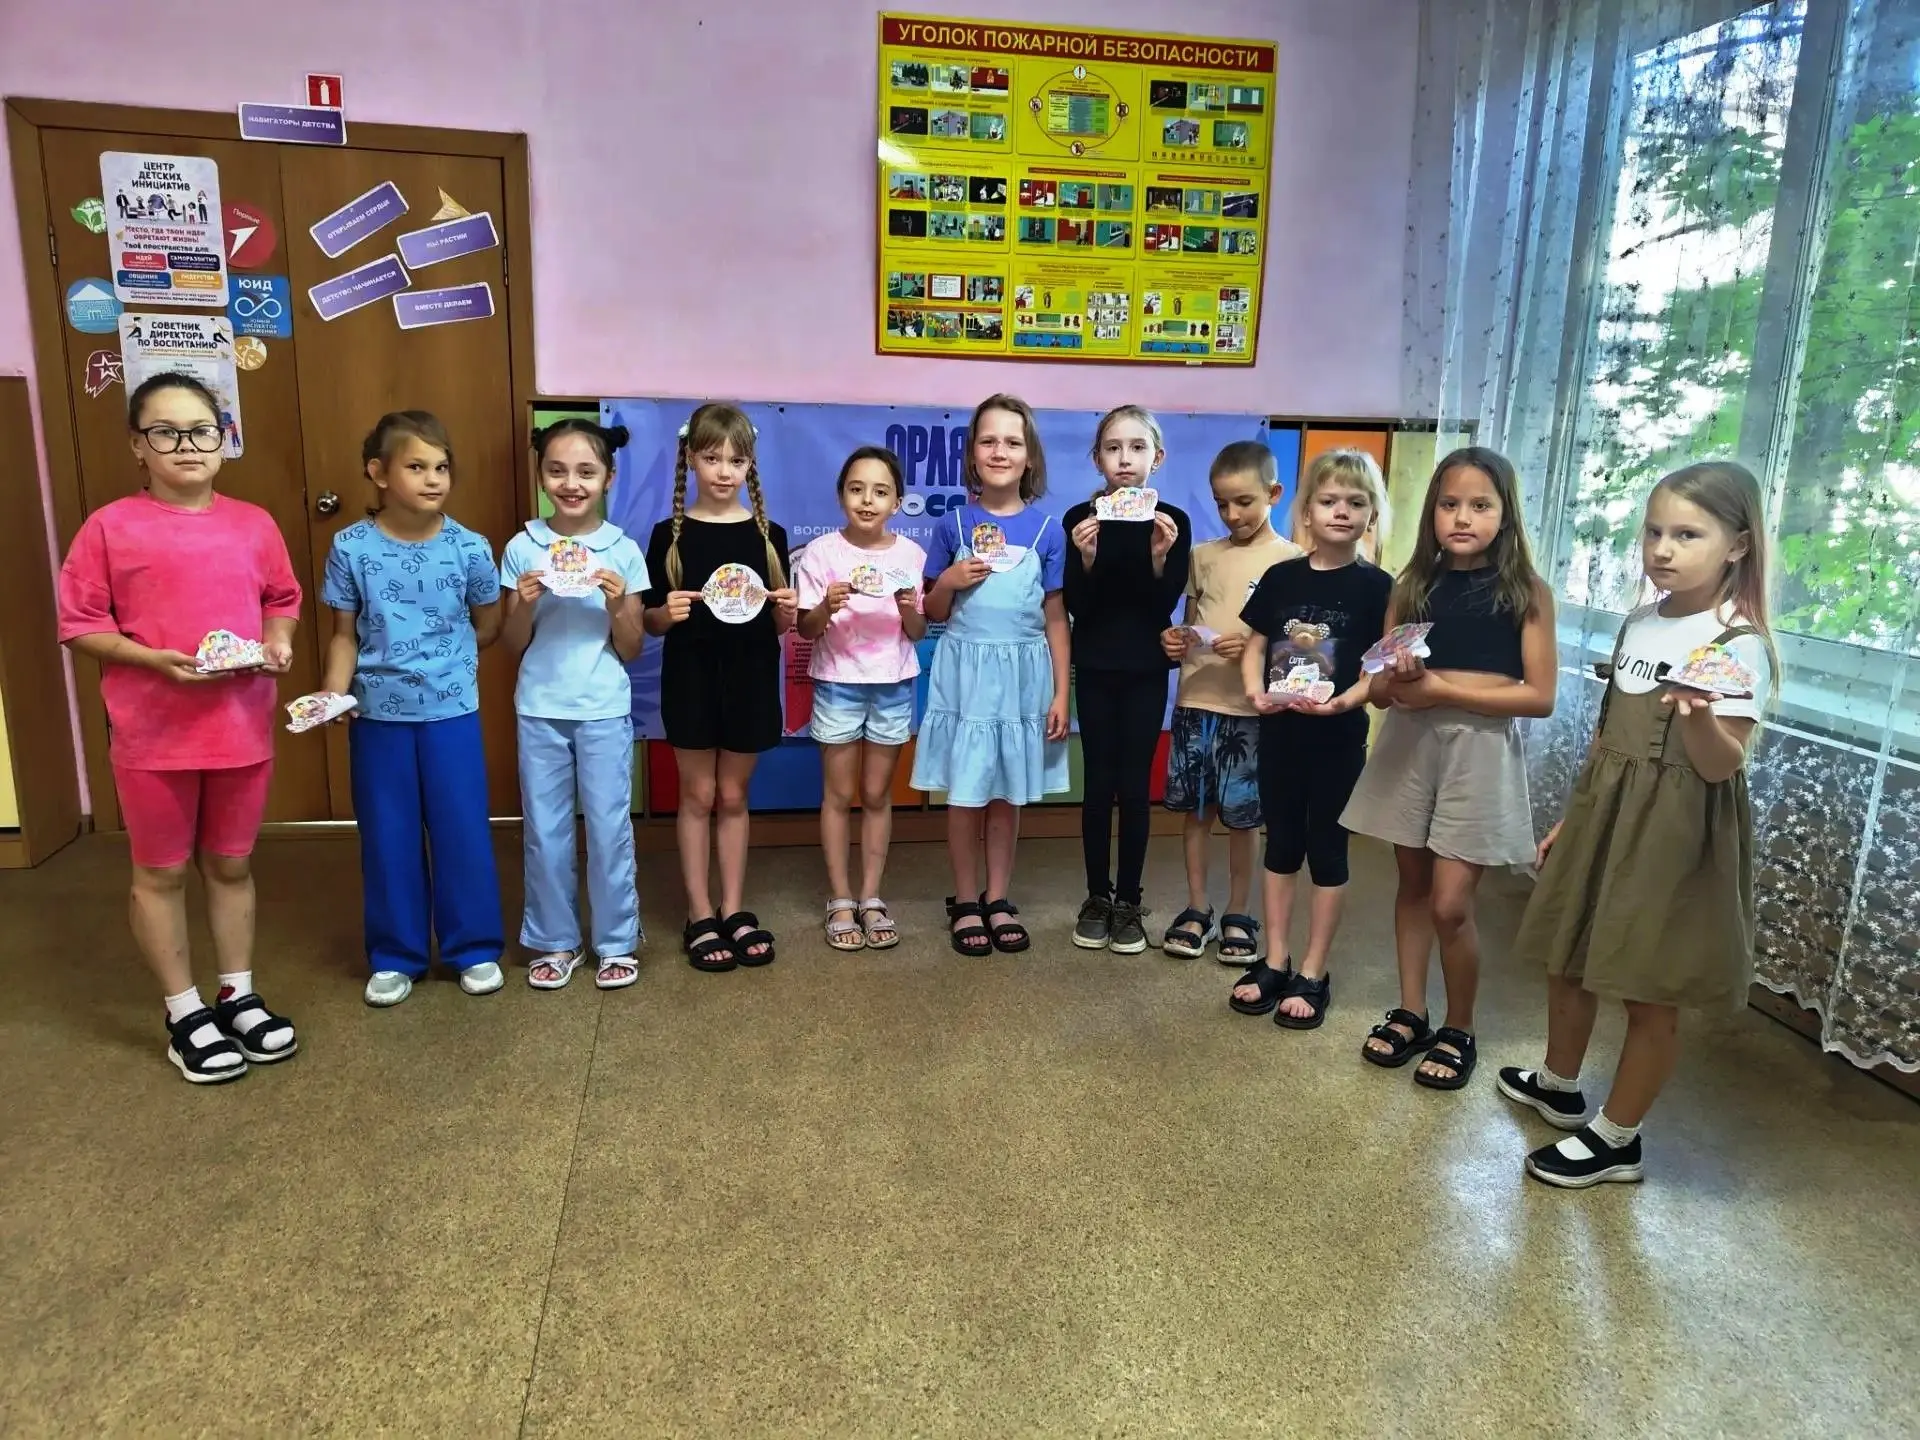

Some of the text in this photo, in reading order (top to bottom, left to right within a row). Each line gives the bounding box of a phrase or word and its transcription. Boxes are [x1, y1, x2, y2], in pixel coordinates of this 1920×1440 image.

[899, 23, 1260, 67] УГОЛОК ПОЖАРНОЙ БЕЗОПАСНОСТИ
[248, 116, 336, 129] НАВИГАТОРЫ ДЕТСТВА
[144, 161, 175, 171] ЦЕНТР
[139, 171, 182, 181] ДЕТСКИХ
[132, 180, 190, 191] ИНИЦИАТИВ
[238, 279, 273, 292] ЮИД
[321, 271, 397, 305] ДЕТСТВО НАЧИНАЕТСЯ
[414, 299, 473, 311] ВМЕСТЕ ДЕЛАЕМ
[152, 321, 200, 331] СОВЕТНИК
[150, 330, 204, 340] ДИРЕКТОРА
[138, 339, 218, 349] ПО ВОСПИТАНИЮ
[886, 424, 968, 486] ОРЛЯ
[902, 494, 968, 517] ОСС
[1288, 655, 1307, 666] CUTE
